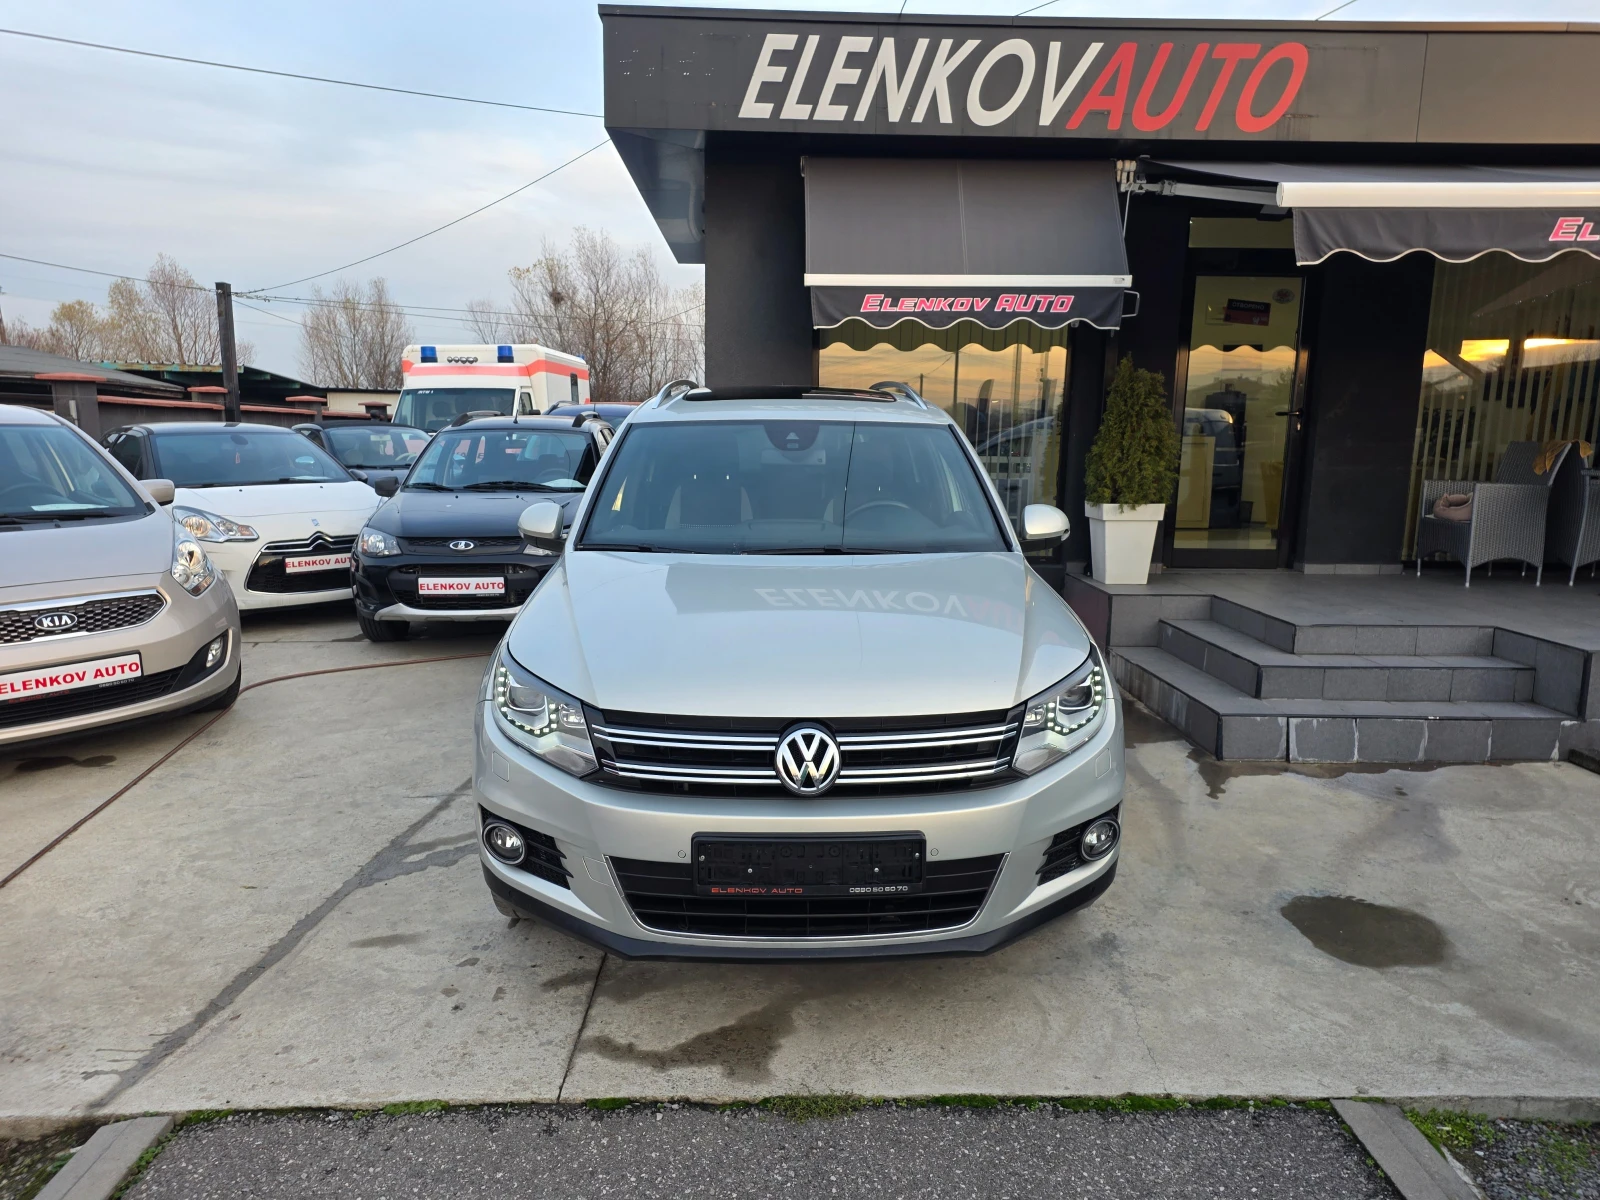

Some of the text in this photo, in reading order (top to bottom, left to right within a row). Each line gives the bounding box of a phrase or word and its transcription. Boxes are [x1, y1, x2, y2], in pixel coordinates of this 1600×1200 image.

[1549, 217, 1600, 241] EL
[994, 294, 1075, 313] AUTO
[285, 556, 352, 569] ELENKOV AUT
[419, 582, 505, 591] ELENKOV AUTO
[43, 615, 72, 627] KIA
[0, 662, 140, 694] ELENKOV AUTO
